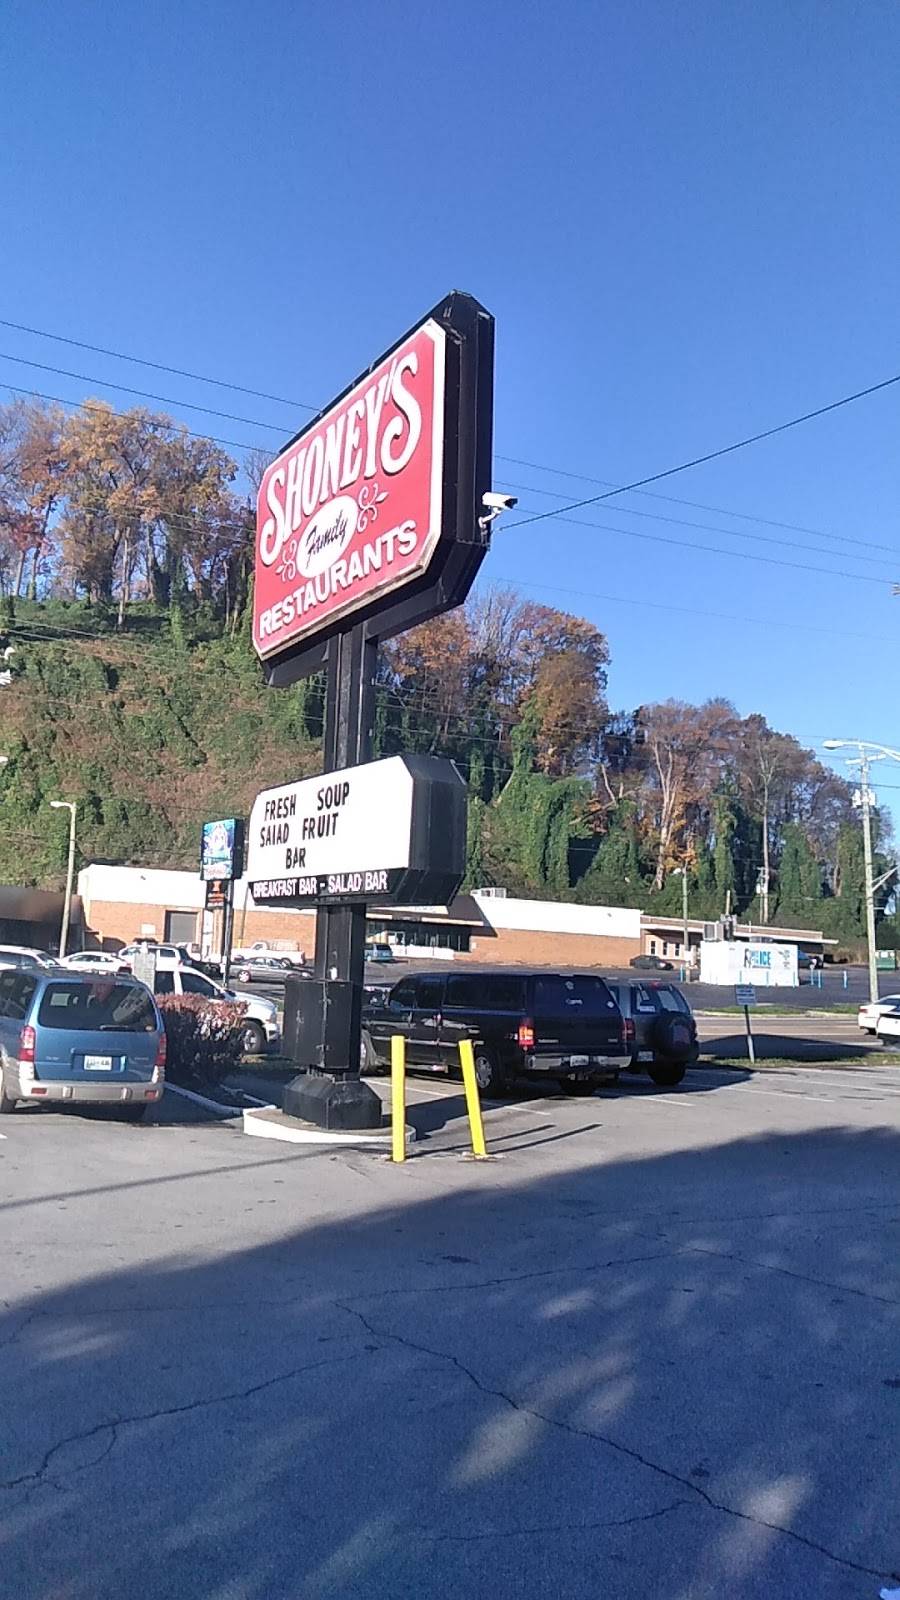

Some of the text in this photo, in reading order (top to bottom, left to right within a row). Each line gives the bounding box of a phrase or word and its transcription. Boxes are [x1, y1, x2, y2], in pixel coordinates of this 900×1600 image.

[259, 352, 421, 566] SHONEY'S
[305, 510, 350, 569] Family
[259, 519, 417, 639] RESTAURANTS
[265, 782, 349, 821] FRESH SOUP
[302, 812, 338, 840] FRUIT
[285, 847, 306, 869] BAR
[253, 878, 298, 898] BREAKFAST
[299, 877, 317, 895] BAR
[328, 873, 362, 893] SALAD
[364, 870, 388, 891] BAR
